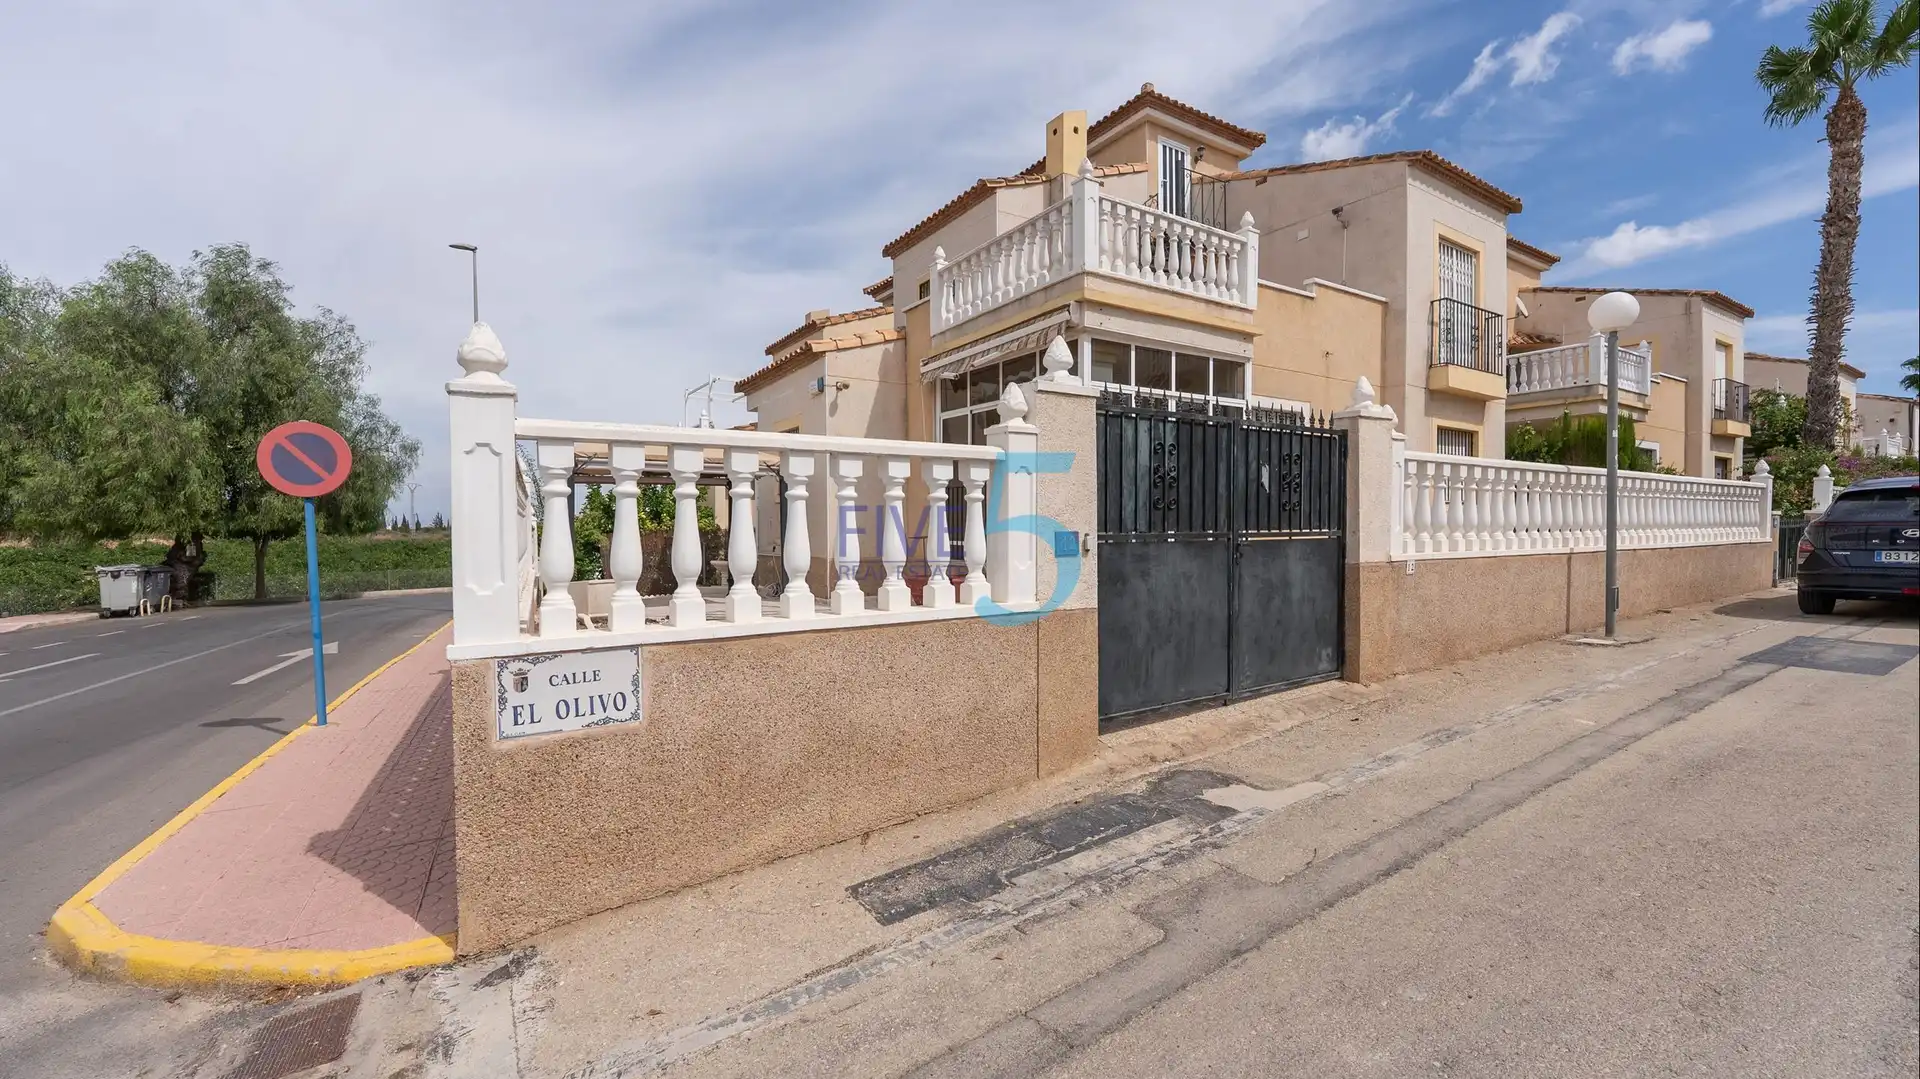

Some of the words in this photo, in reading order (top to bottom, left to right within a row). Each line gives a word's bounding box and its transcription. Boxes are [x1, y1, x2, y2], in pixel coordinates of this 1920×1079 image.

[1884, 551, 1919, 561] 8312
[549, 669, 602, 687] CALLE
[511, 703, 542, 727] EL
[555, 691, 627, 720] OLIVO
